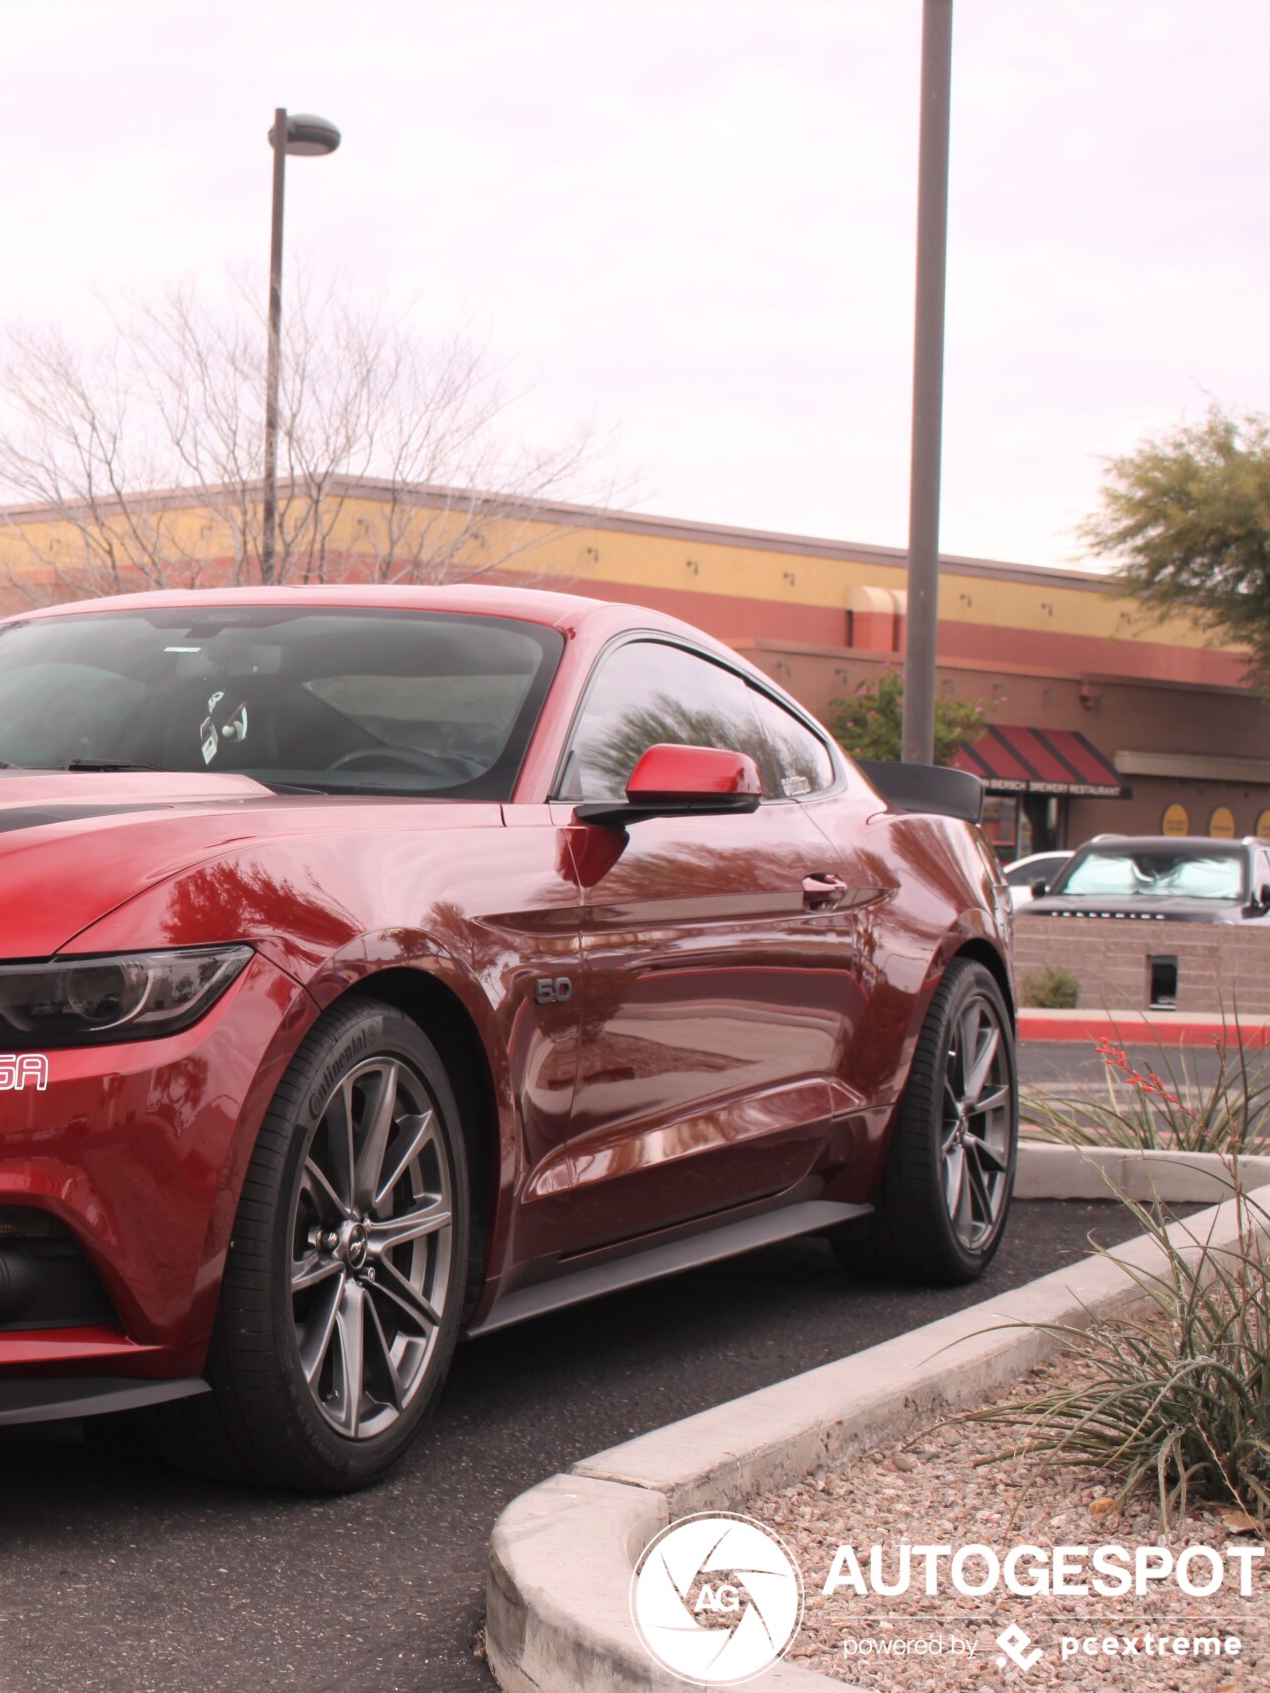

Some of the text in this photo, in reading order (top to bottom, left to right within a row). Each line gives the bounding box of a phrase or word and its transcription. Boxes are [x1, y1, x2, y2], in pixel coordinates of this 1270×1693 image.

[1029, 781, 1068, 793] BREWERY
[1069, 784, 1121, 797] RESTAURANT
[308, 1028, 367, 1121] Continental
